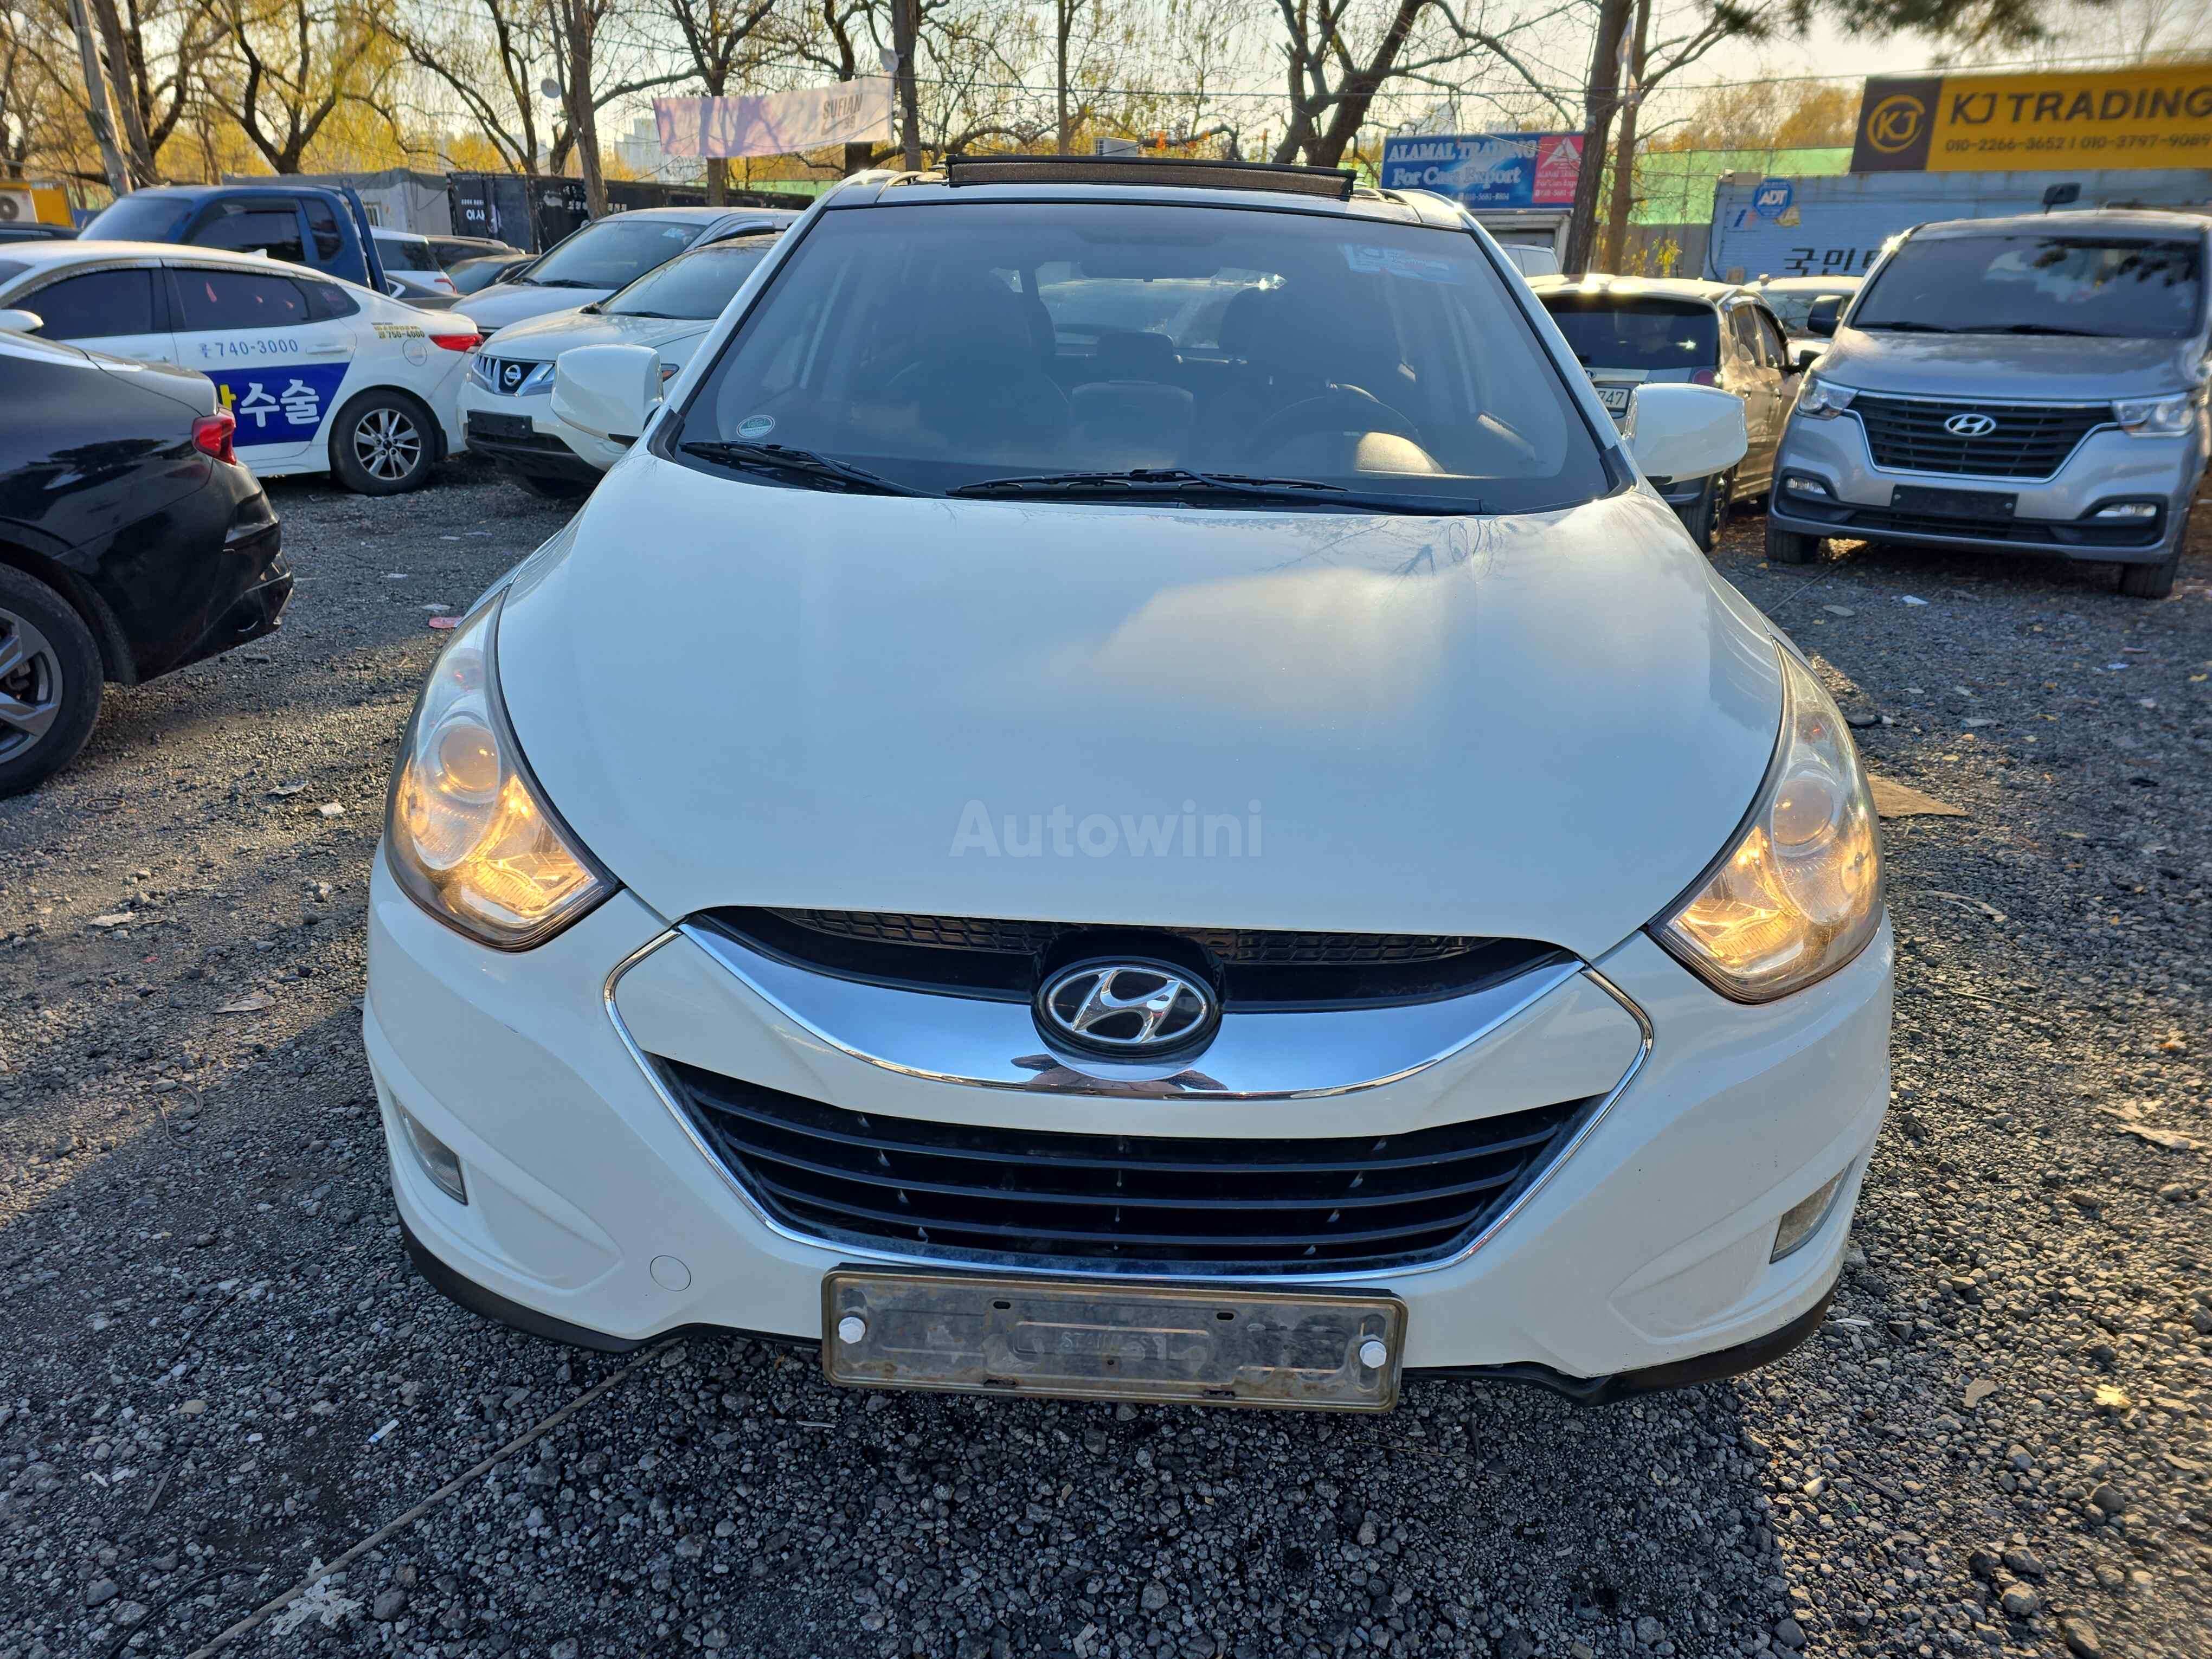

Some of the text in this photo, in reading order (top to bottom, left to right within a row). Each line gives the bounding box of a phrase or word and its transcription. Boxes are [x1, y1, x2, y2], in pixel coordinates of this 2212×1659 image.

[823, 93, 863, 120] SUFIAN
[1950, 85, 2212, 125] KJ TRADING
[1387, 143, 1456, 163] ALAMAL
[1392, 168, 1422, 186] For
[1758, 190, 1788, 206] ADT
[215, 338, 298, 358] 740-3000
